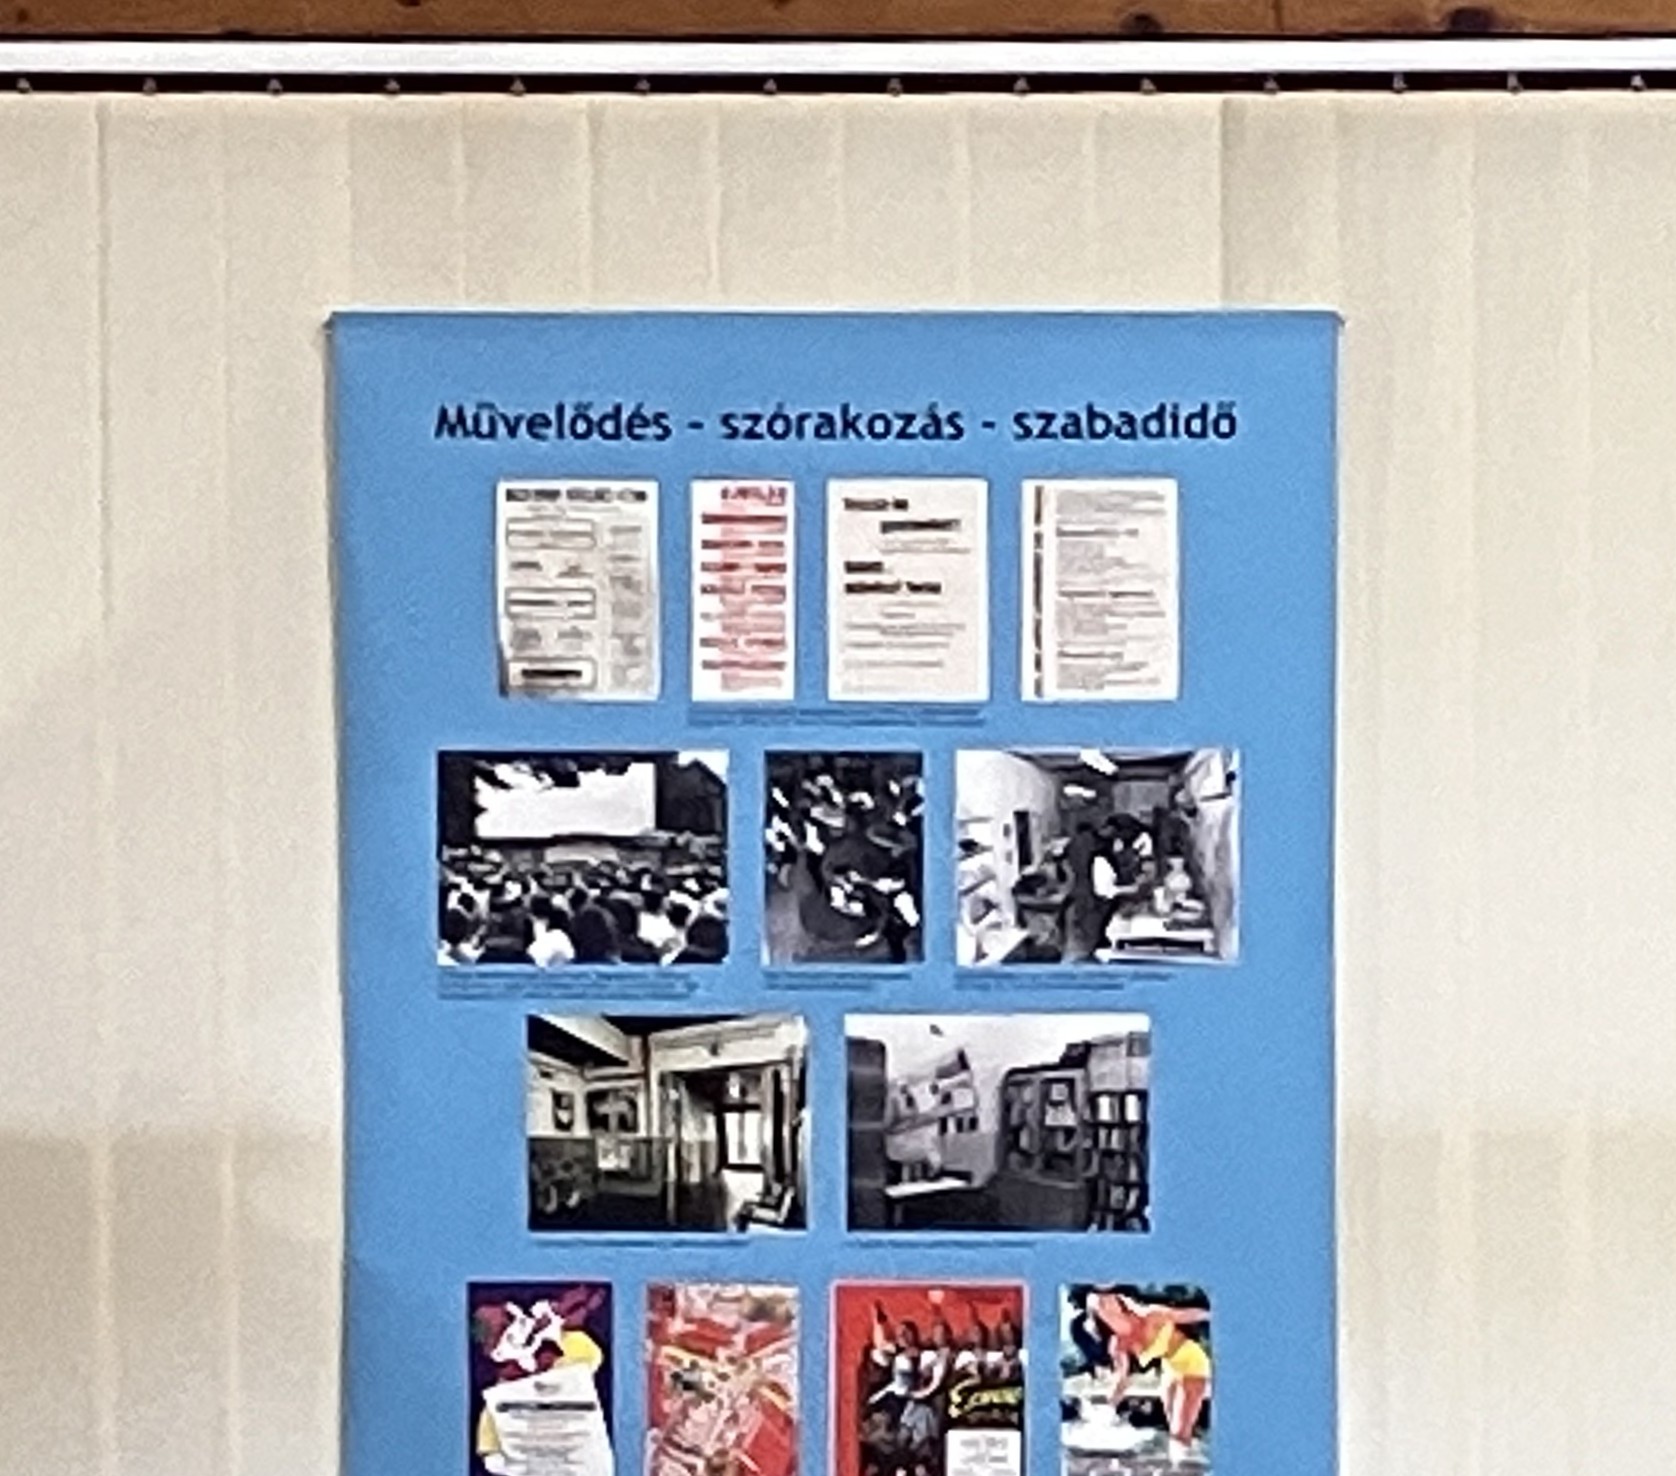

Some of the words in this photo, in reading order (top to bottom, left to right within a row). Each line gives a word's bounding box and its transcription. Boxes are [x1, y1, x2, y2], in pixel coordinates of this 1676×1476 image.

[434, 400, 673, 441] Művelődés
[720, 400, 965, 441] szórakozás
[1012, 401, 1237, 440] szabadidő
